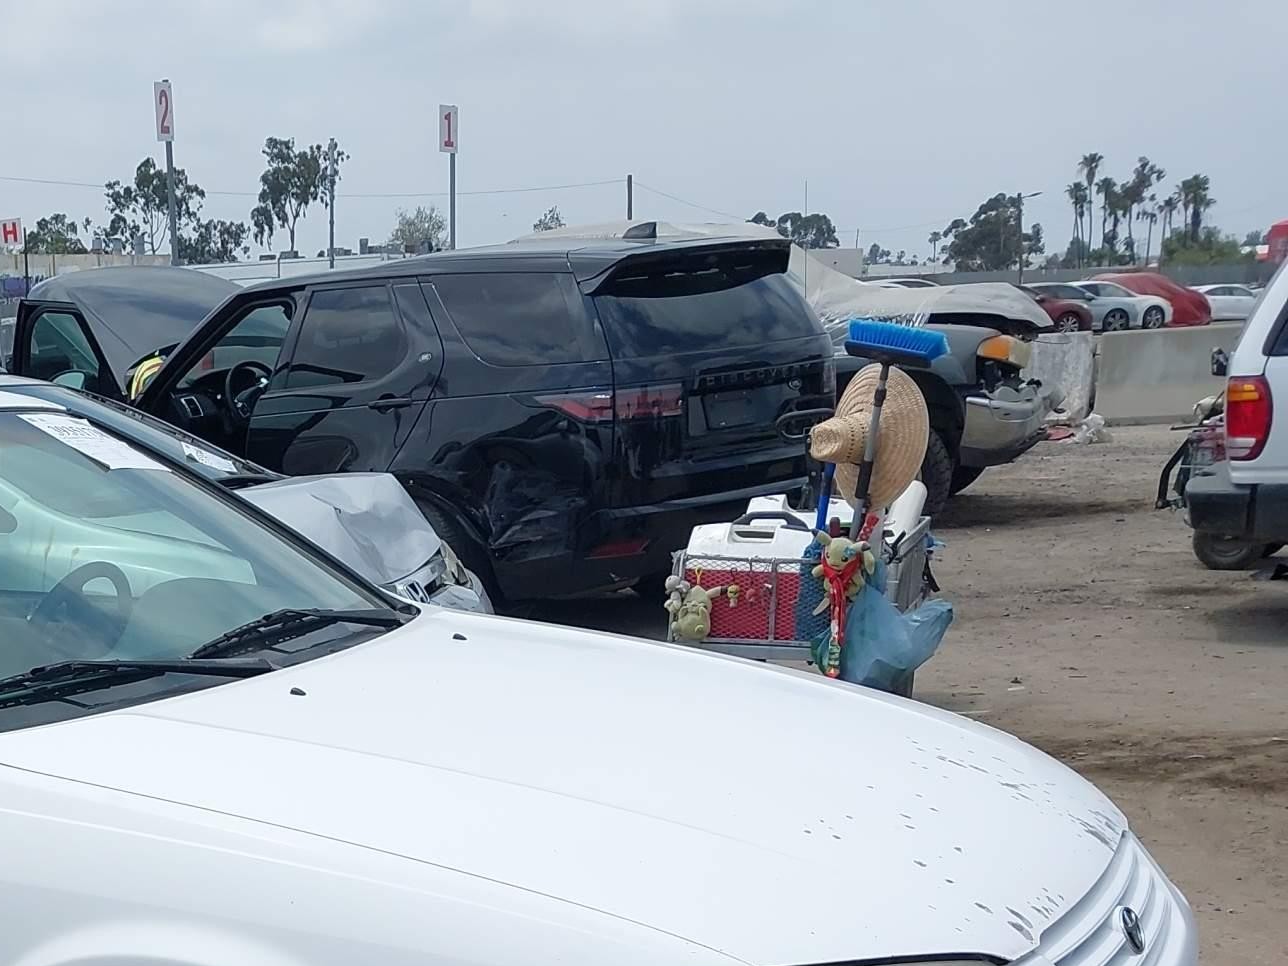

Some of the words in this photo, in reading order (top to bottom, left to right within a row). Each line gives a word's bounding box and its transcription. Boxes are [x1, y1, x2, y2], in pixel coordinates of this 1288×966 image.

[159, 89, 170, 134] 2
[444, 111, 454, 148] 1
[2, 222, 18, 244] H
